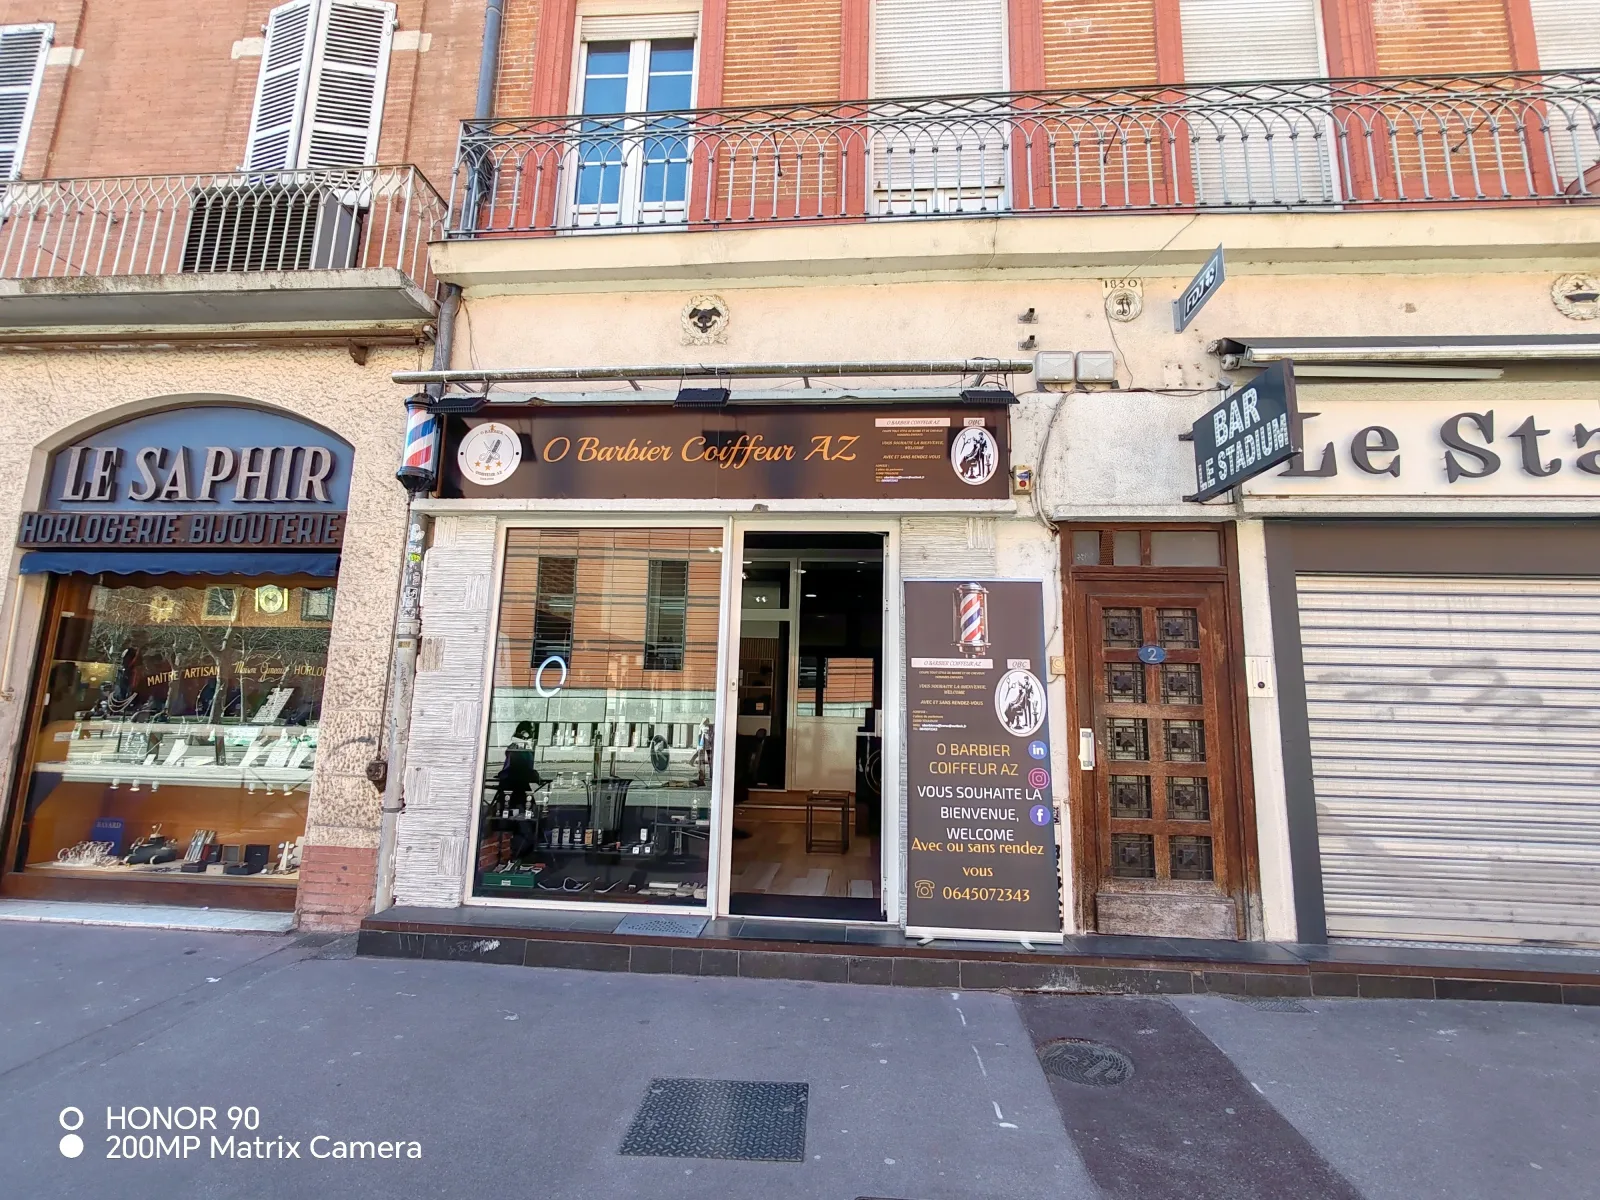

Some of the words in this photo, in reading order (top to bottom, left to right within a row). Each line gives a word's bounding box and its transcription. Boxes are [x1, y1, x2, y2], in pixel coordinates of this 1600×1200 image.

[1186, 278, 1205, 313] FDJ
[1213, 387, 1261, 448] BAR
[543, 436, 572, 463] O
[577, 437, 674, 462] Barbier
[681, 436, 797, 470] Coiffeur
[804, 434, 861, 462] AZ
[1198, 457, 1216, 492] LE
[1217, 412, 1289, 481] STADIUM
[1277, 411, 1400, 478] Le
[58, 446, 123, 503] LE
[128, 445, 336, 503] SAPHIR
[20, 513, 182, 544] HORLOGERIE
[1147, 648, 1158, 661] 2
[184, 665, 221, 679] ARTISAN
[936, 743, 946, 756] O
[950, 744, 1010, 756] BARBIER
[929, 762, 997, 776] COIFFEUR
[1000, 764, 1019, 776] AZ
[917, 786, 953, 798] VOUS
[956, 786, 1022, 800] SOUHAITE
[1025, 788, 1042, 800] LA
[940, 806, 1020, 822] BIENVENUE,
[946, 828, 1014, 841] WELCOME
[911, 838, 943, 852] Avec
[946, 842, 964, 853] ou
[968, 843, 996, 854] sans
[999, 842, 1044, 855] rendez
[962, 866, 994, 877] vous
[942, 886, 1030, 902] 0645072343
